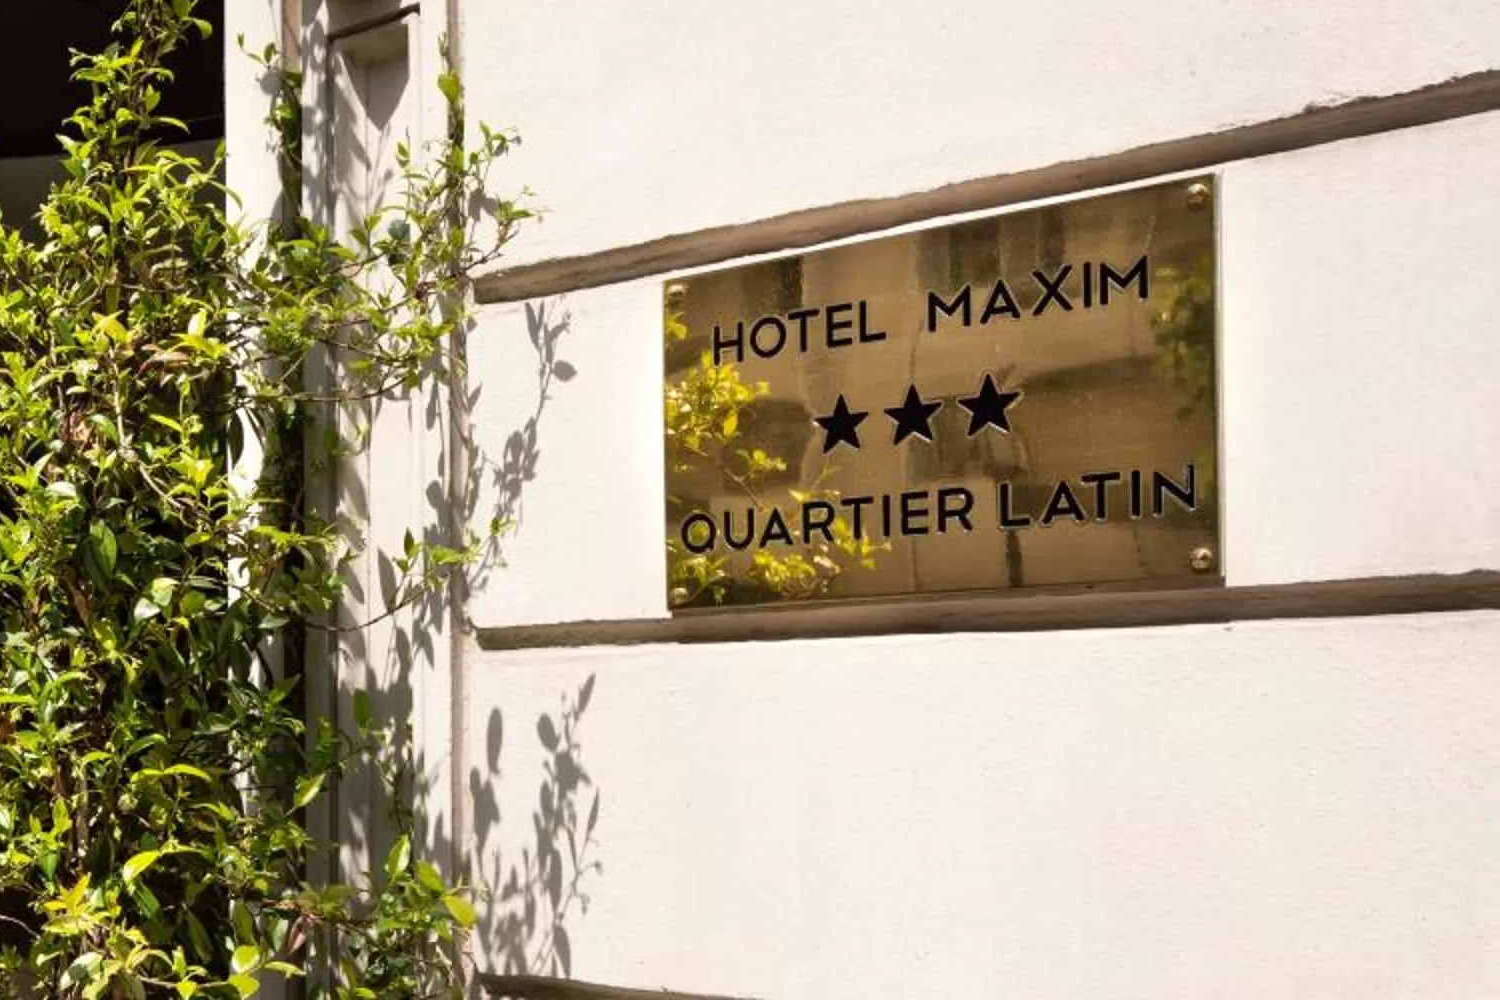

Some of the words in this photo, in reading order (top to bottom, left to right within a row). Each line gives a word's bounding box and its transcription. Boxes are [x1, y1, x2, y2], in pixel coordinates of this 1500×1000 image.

[712, 299, 887, 367] HOTEL
[926, 254, 1149, 334] MAXIM
[680, 487, 975, 555] QUARTIER
[999, 462, 1196, 527] LATIN
